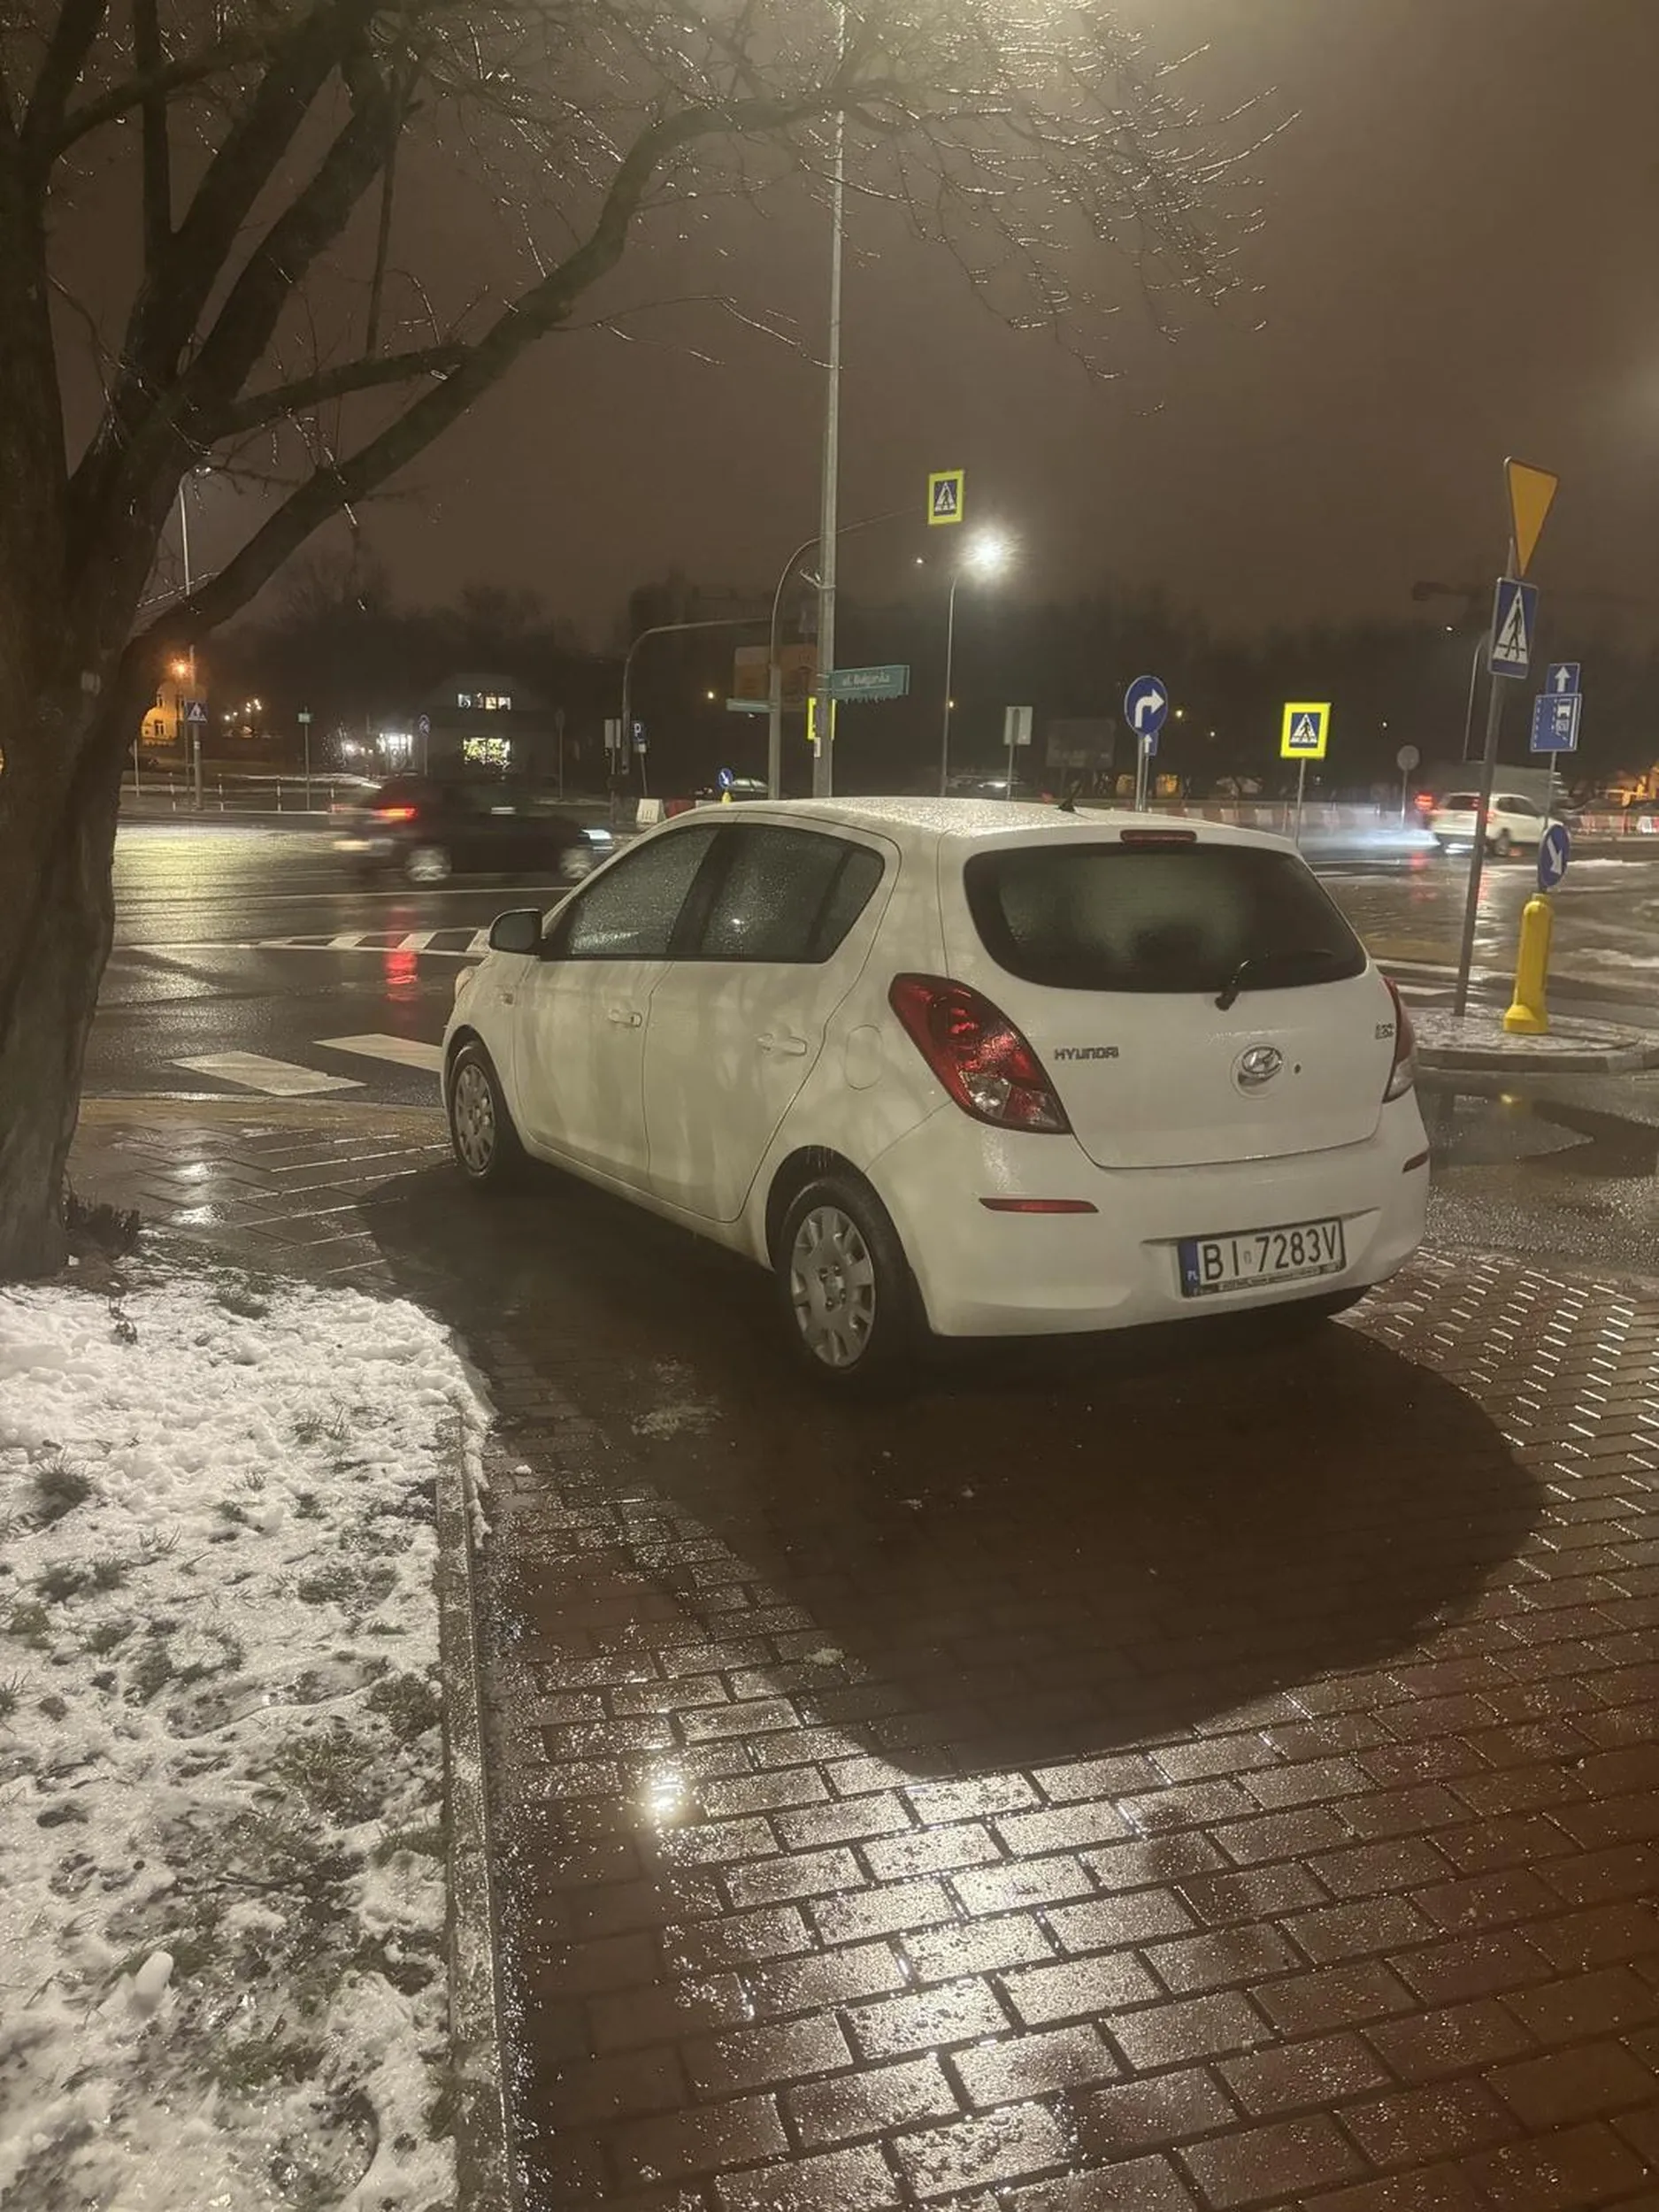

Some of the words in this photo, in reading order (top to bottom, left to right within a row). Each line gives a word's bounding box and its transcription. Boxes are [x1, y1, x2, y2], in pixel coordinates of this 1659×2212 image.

[1054, 1046, 1119, 1060] HYUNDAI
[1202, 1240, 1240, 1280] BI
[1255, 1225, 1336, 1272] 7283V
